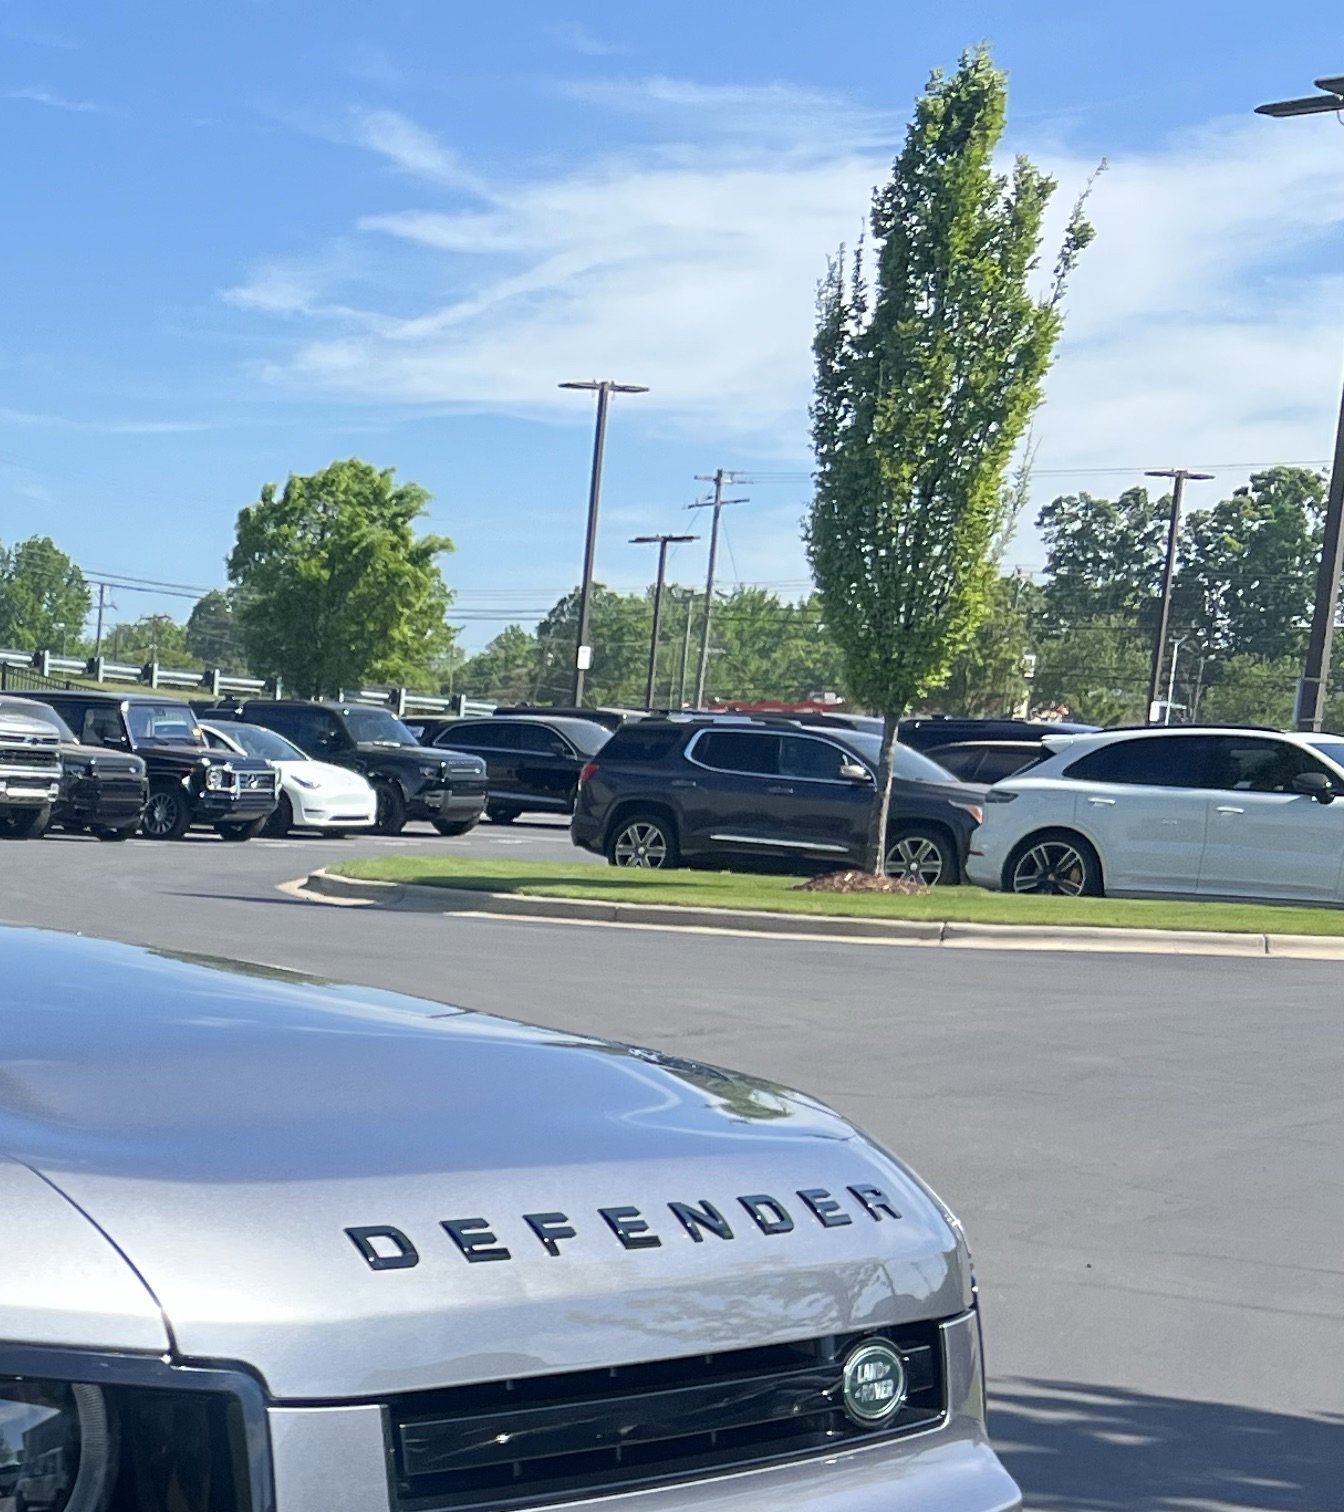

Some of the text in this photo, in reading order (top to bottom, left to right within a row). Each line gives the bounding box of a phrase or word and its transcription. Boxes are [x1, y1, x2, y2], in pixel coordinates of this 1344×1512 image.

[344, 1184, 902, 1271] DEFENDER
[857, 1361, 887, 1384] LAND
[859, 1378, 894, 1402] ROVER
